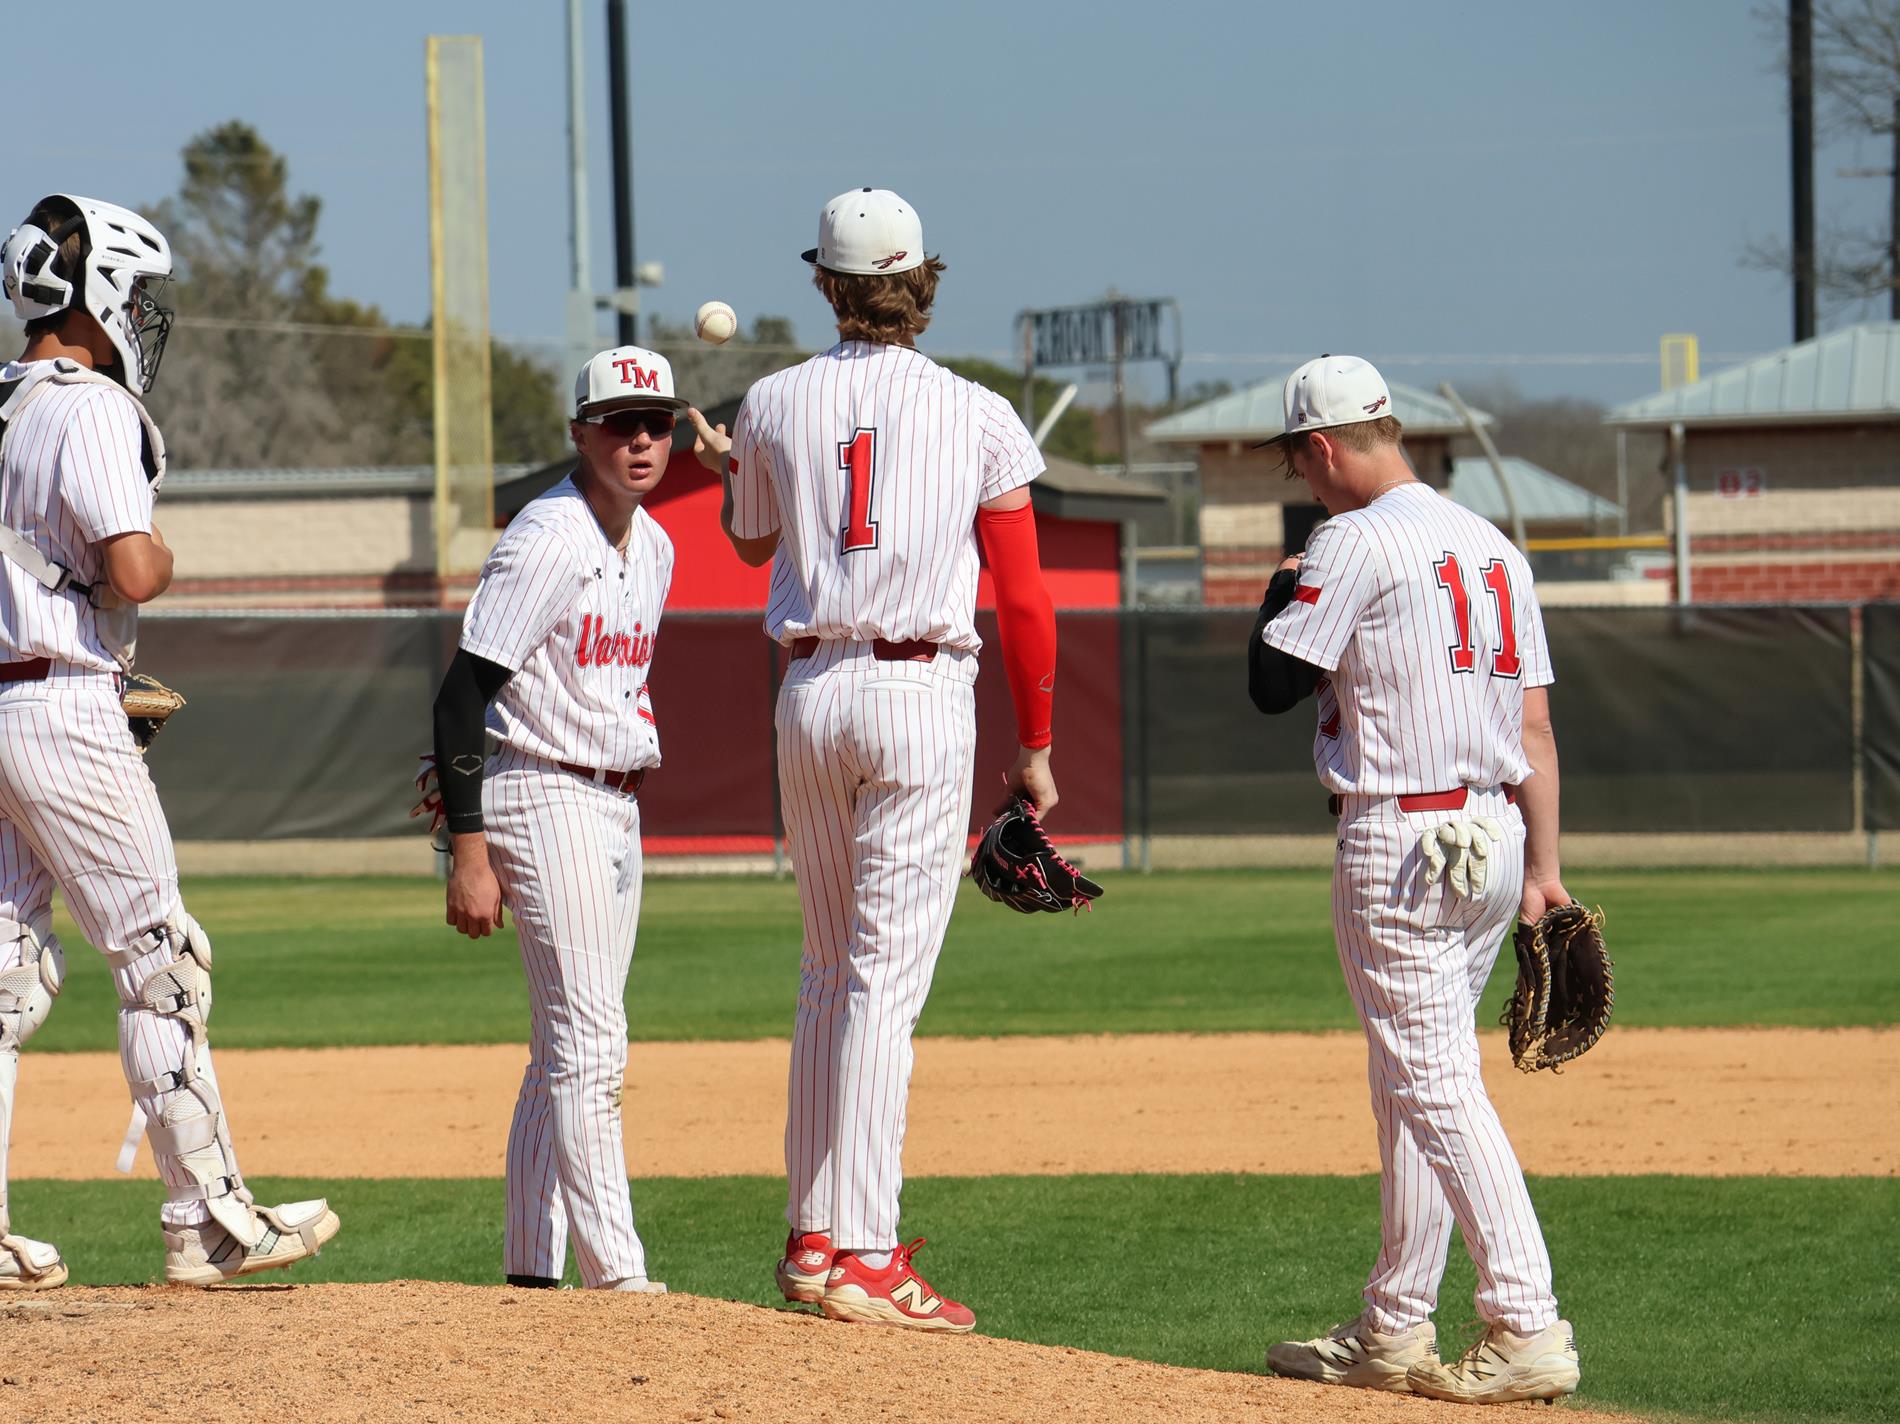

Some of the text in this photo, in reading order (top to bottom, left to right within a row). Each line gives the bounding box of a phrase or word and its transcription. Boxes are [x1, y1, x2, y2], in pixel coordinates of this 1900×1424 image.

[612, 358, 660, 392] TM
[838, 427, 879, 556] 1
[1432, 550, 1522, 680] 11
